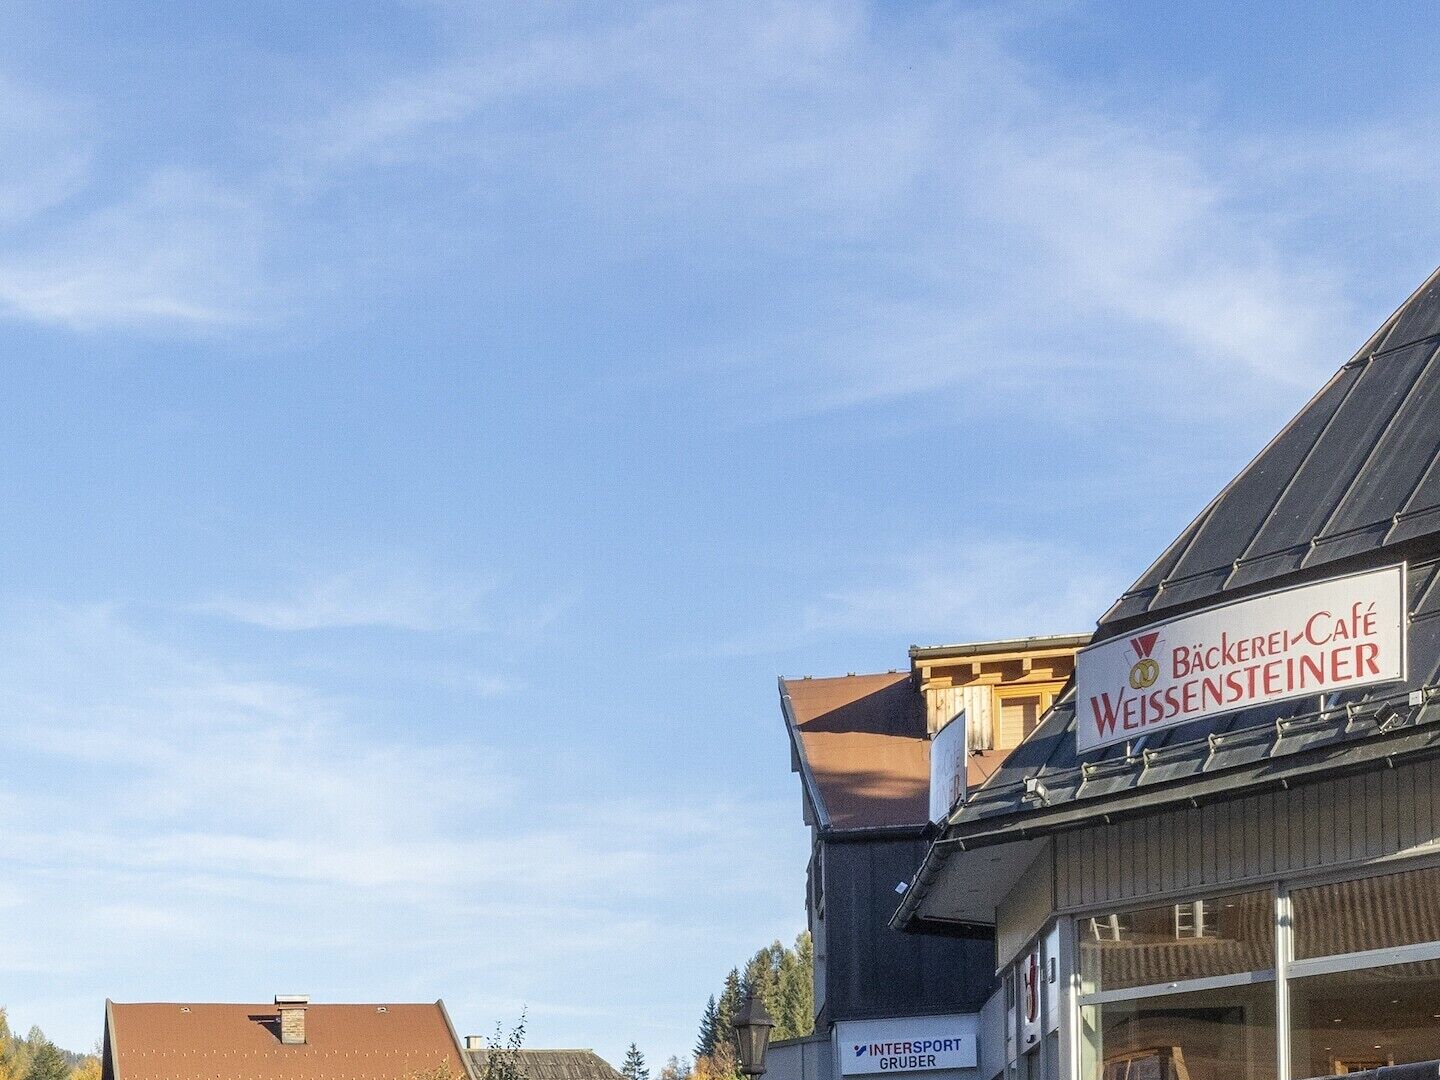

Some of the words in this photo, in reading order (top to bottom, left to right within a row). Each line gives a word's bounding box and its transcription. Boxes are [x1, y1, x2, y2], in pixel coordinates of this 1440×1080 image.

[1090, 642, 1380, 738] WEISSENSTEINER
[869, 1039, 961, 1056] INTERSPORT
[880, 1055, 936, 1069] GRUBER
